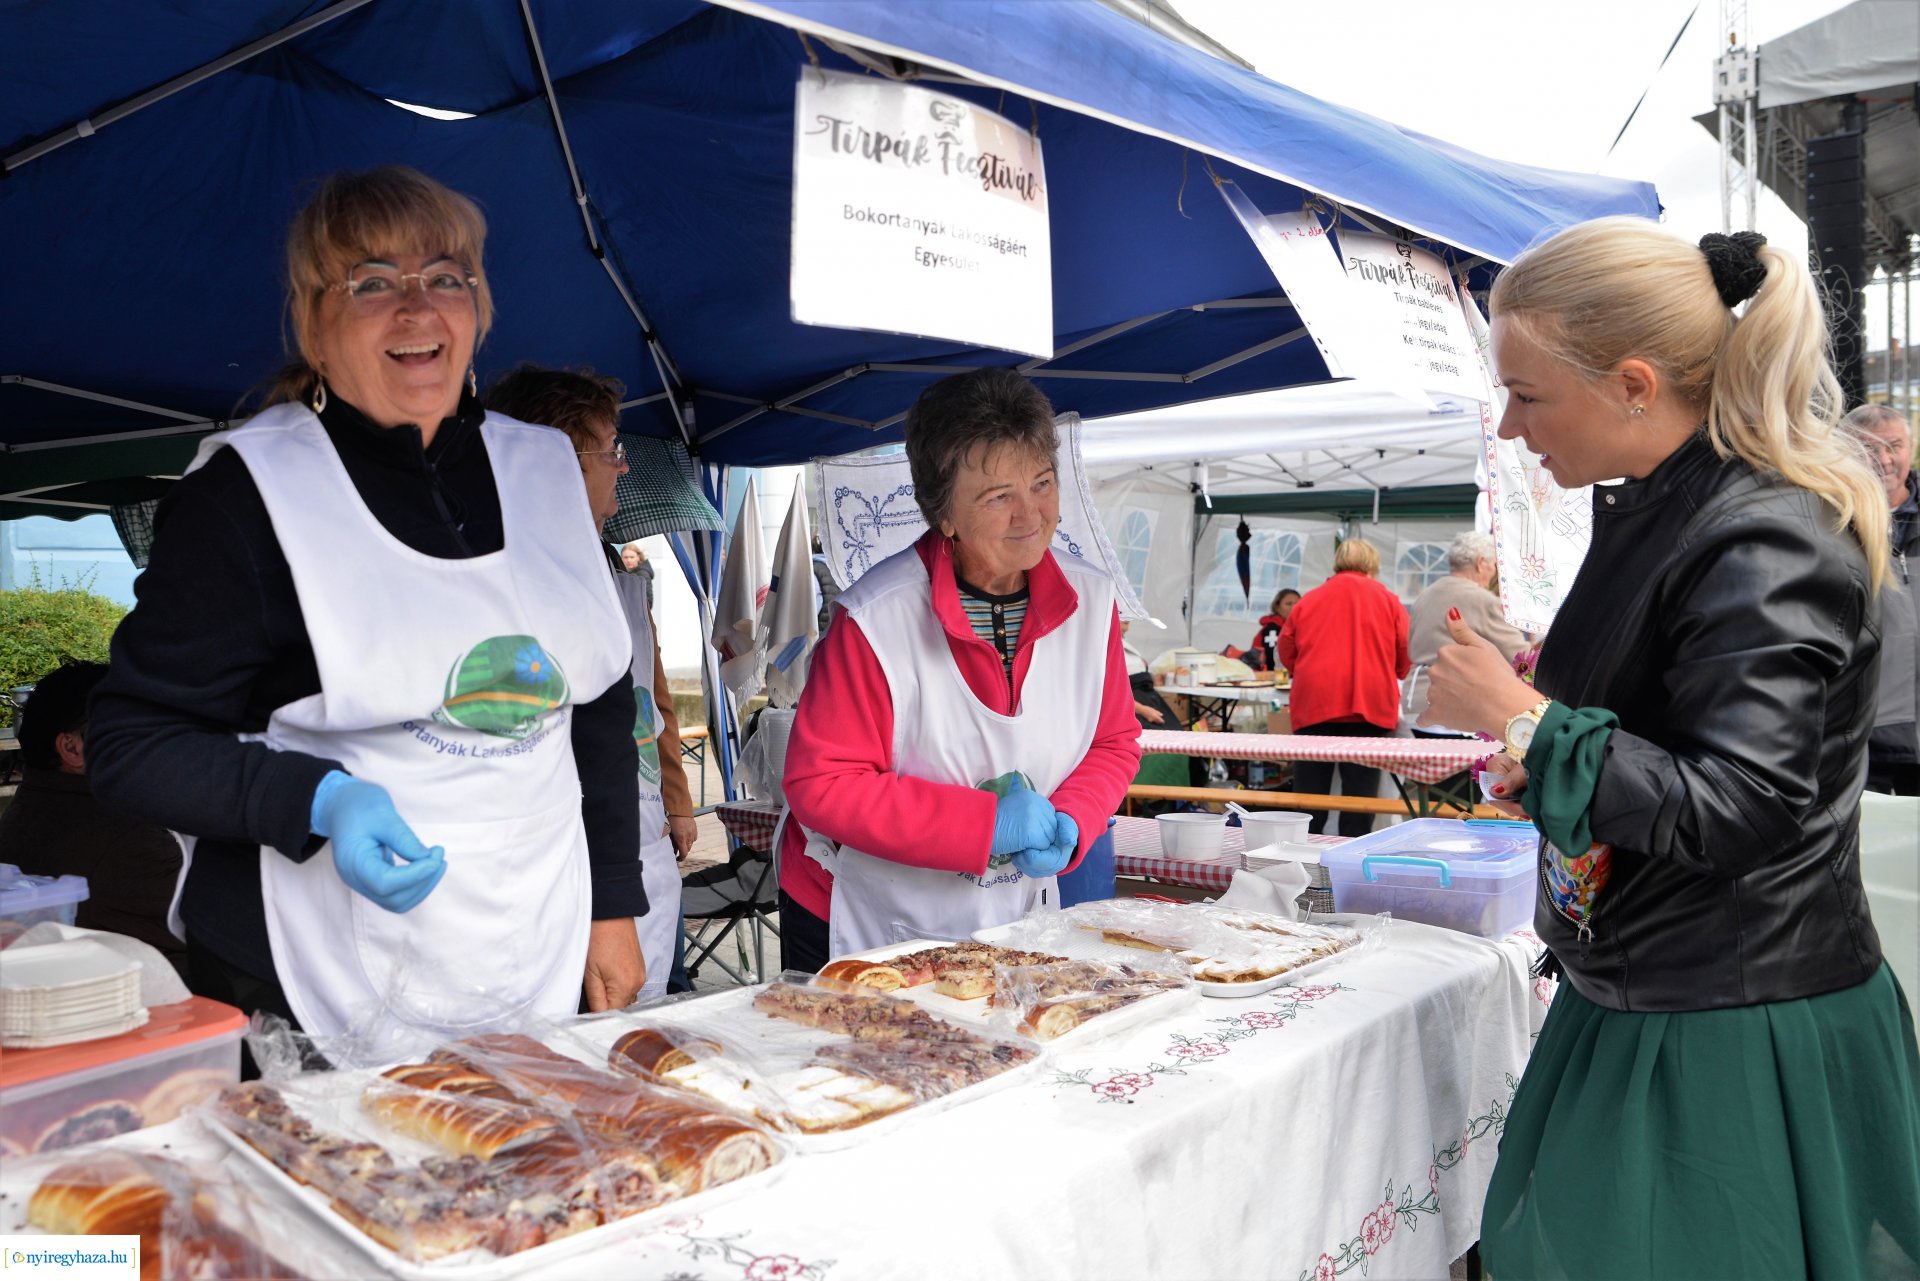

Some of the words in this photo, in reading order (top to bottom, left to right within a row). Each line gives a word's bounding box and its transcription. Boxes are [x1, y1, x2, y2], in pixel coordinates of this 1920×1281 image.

[804, 115, 931, 167] Tirpák
[937, 131, 1045, 201] Fesztivál
[842, 203, 946, 236] Bokortanyák
[951, 224, 1028, 258] Lakosságáért
[1347, 257, 1407, 286] Tirpák
